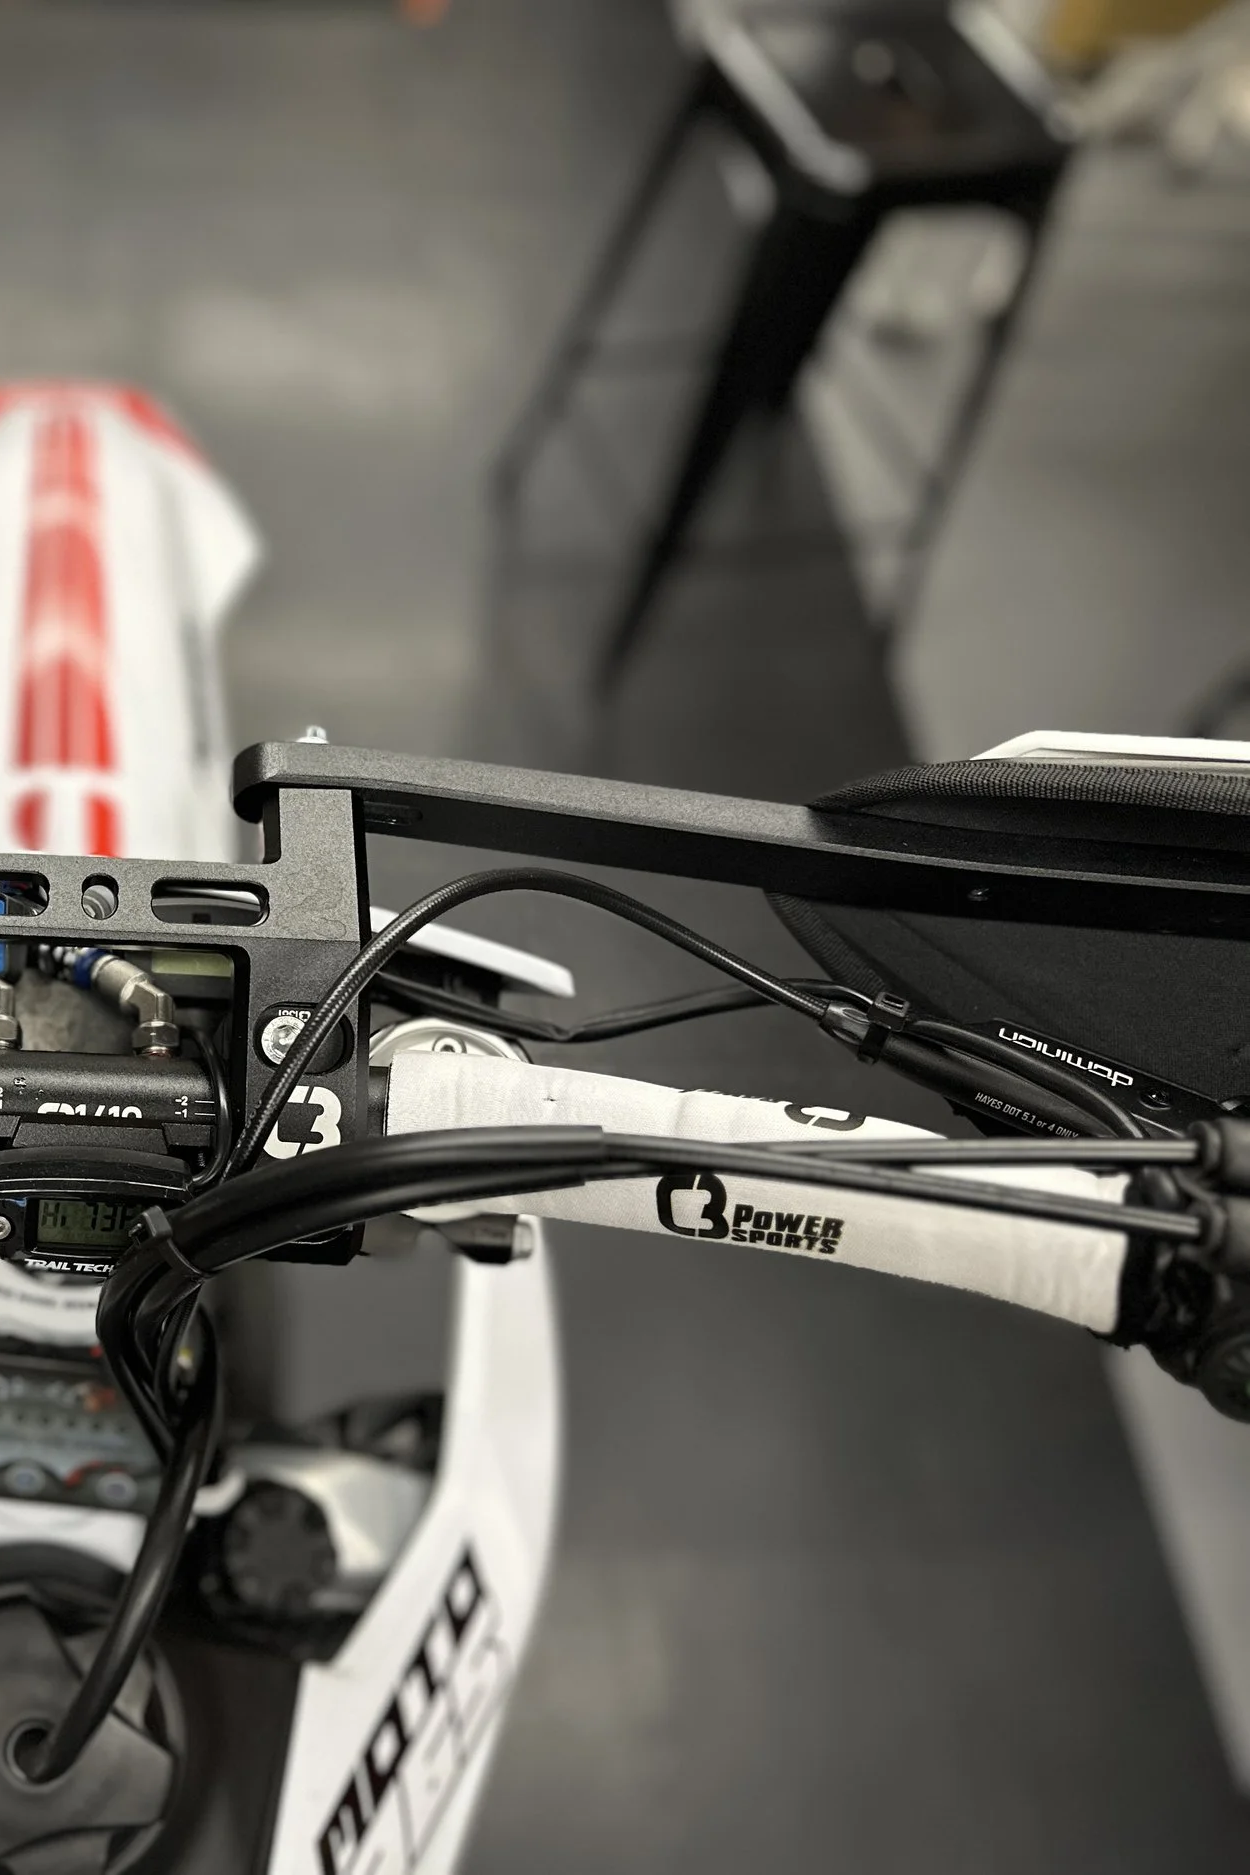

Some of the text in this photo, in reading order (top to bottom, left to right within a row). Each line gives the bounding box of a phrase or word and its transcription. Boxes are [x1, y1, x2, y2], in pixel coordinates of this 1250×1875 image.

[998, 1027, 1134, 1087] dominion
[974, 1092, 1003, 1110] HAYES
[1002, 1104, 1022, 1118] DOT
[1021, 1112, 1037, 1124] 5.1
[1036, 1120, 1047, 1128] or
[1047, 1123, 1055, 1132] 4
[731, 1203, 845, 1240] POWER
[730, 1228, 840, 1256] SPORTS
[24, 1258, 115, 1273] TRAIL TECH
[317, 1540, 490, 1875] MOTO
